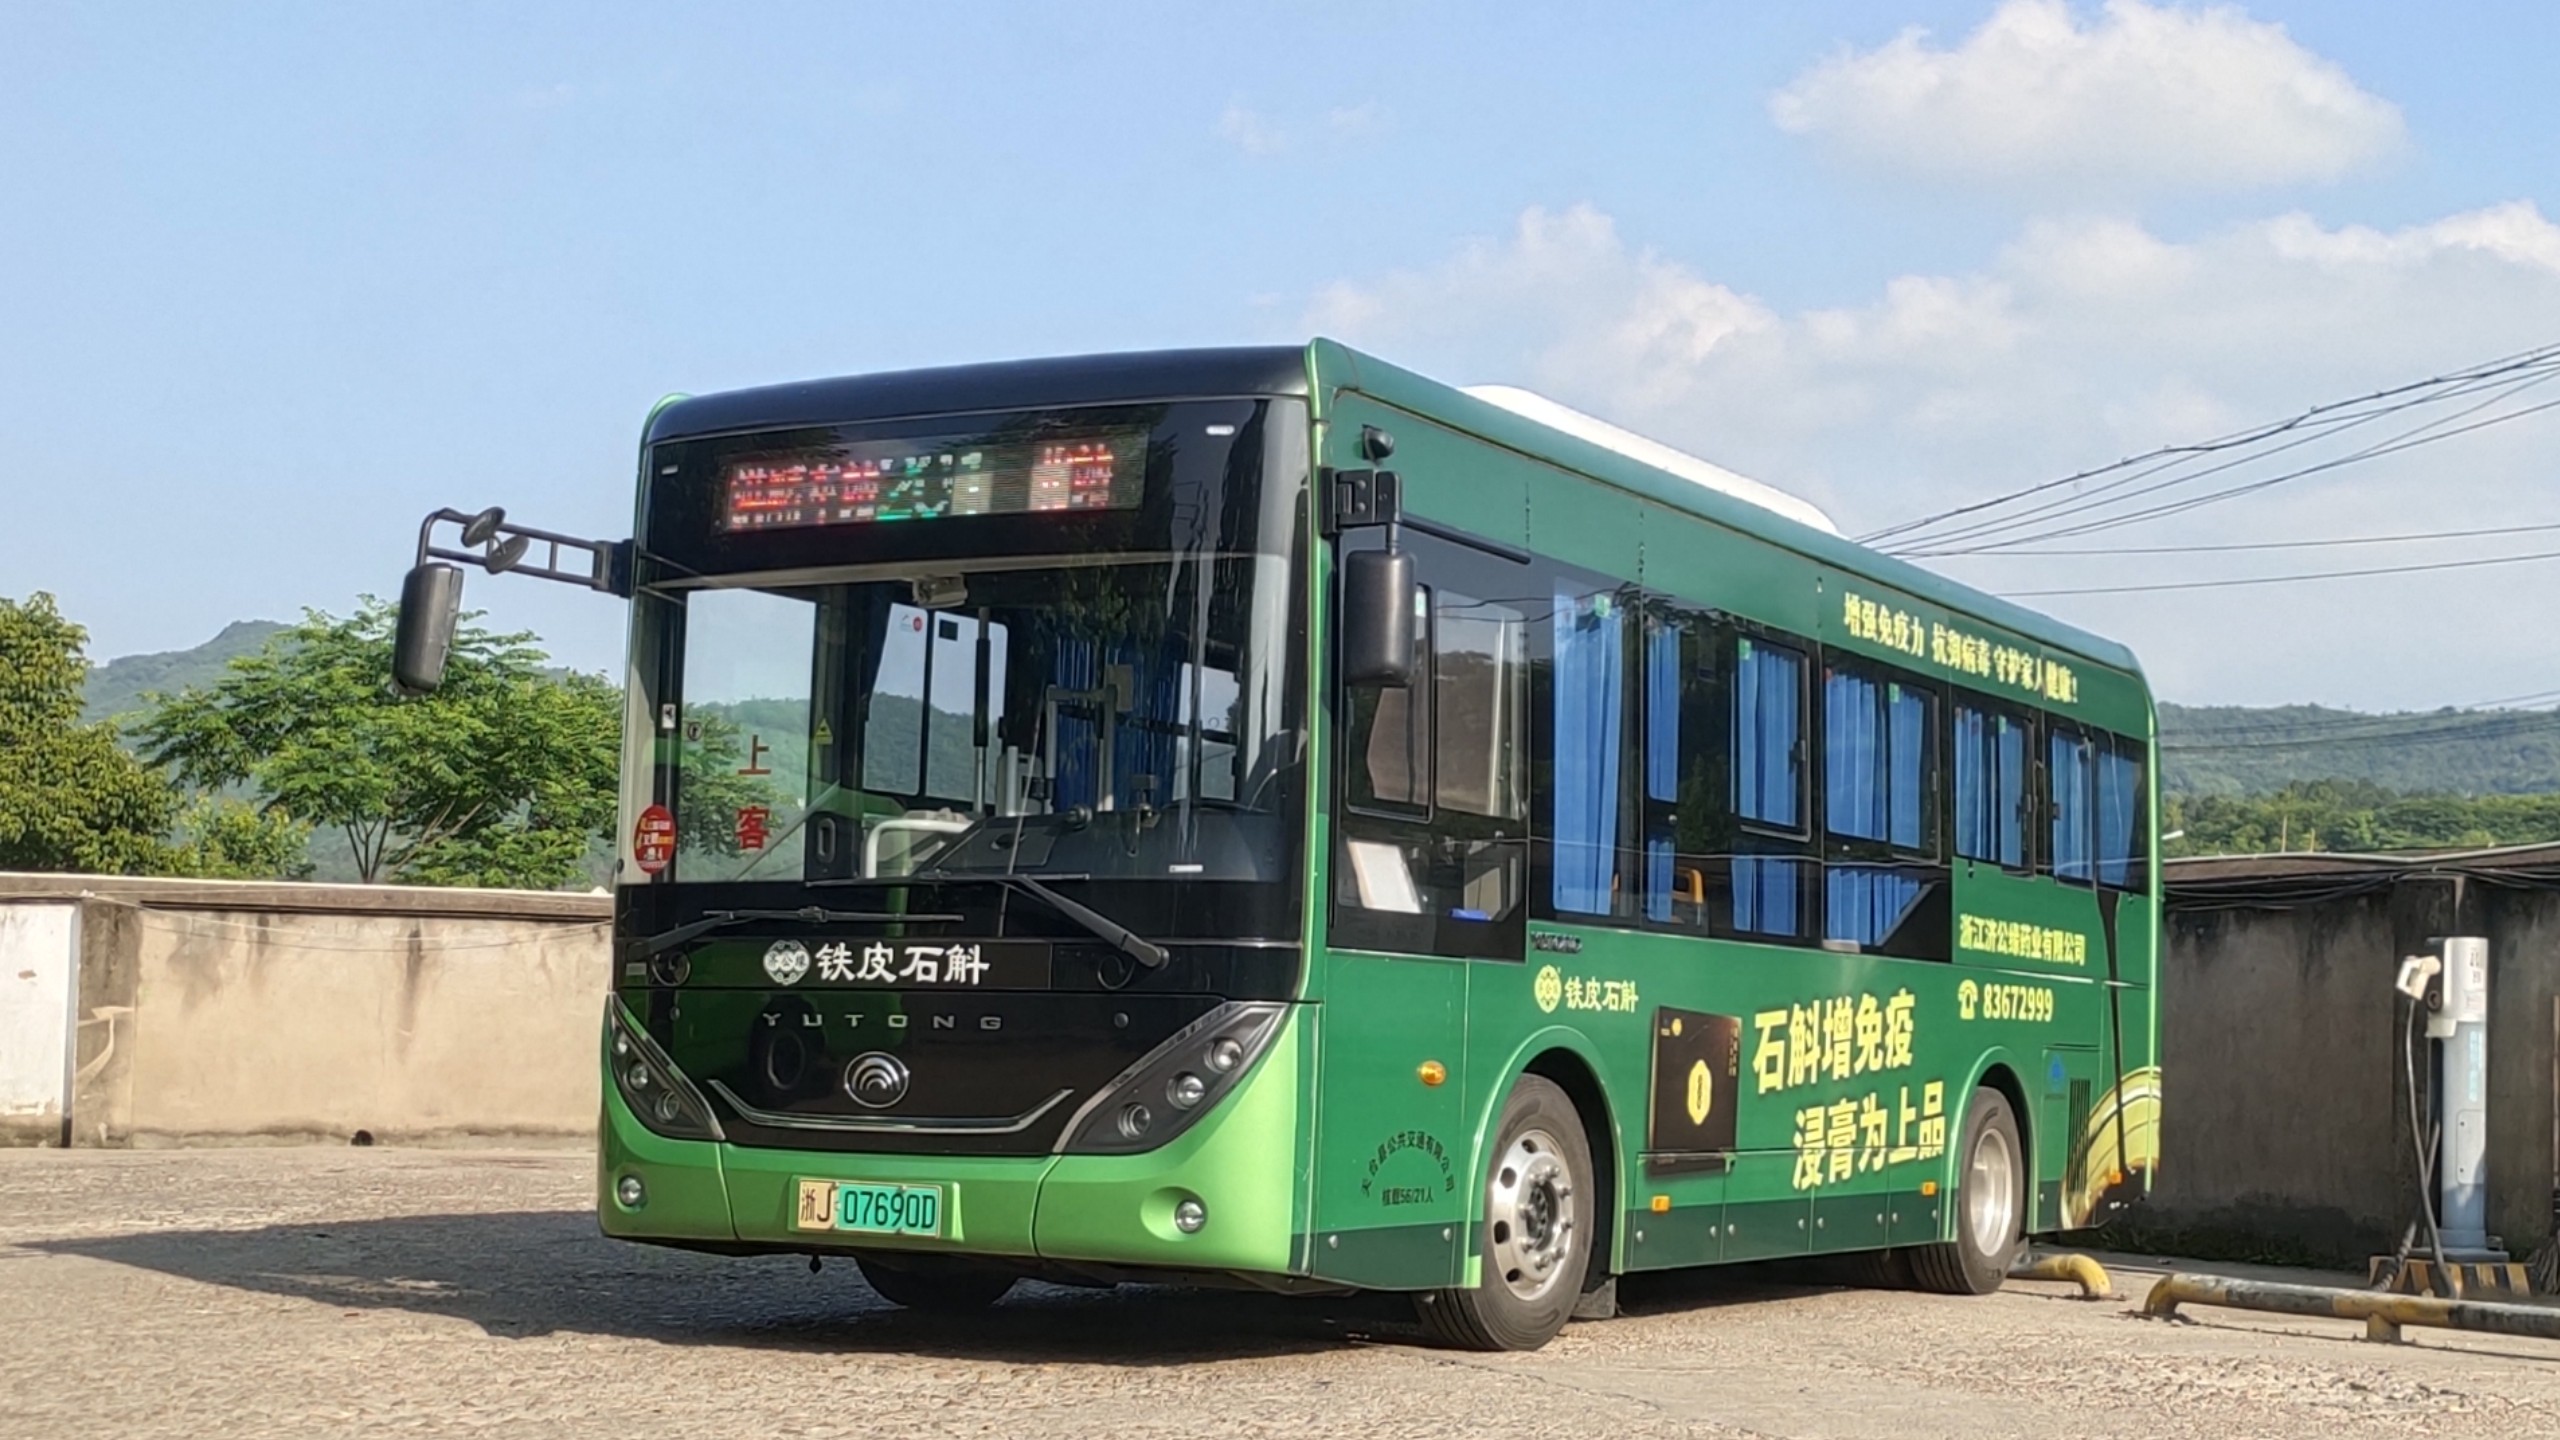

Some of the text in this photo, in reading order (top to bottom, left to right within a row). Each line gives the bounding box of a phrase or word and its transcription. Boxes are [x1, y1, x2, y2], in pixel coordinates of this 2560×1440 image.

[1844, 591, 1925, 658] 增强免疫力
[814, 941, 991, 986] 铁皮石斛
[1564, 975, 1640, 1014] 铁皮石斛
[1983, 983, 2054, 1022] 83672999
[762, 1012, 1002, 1030] YUTONG
[1752, 987, 1916, 1095] 石斛增免疫
[1791, 1081, 1946, 1191] 浸膏为上品
